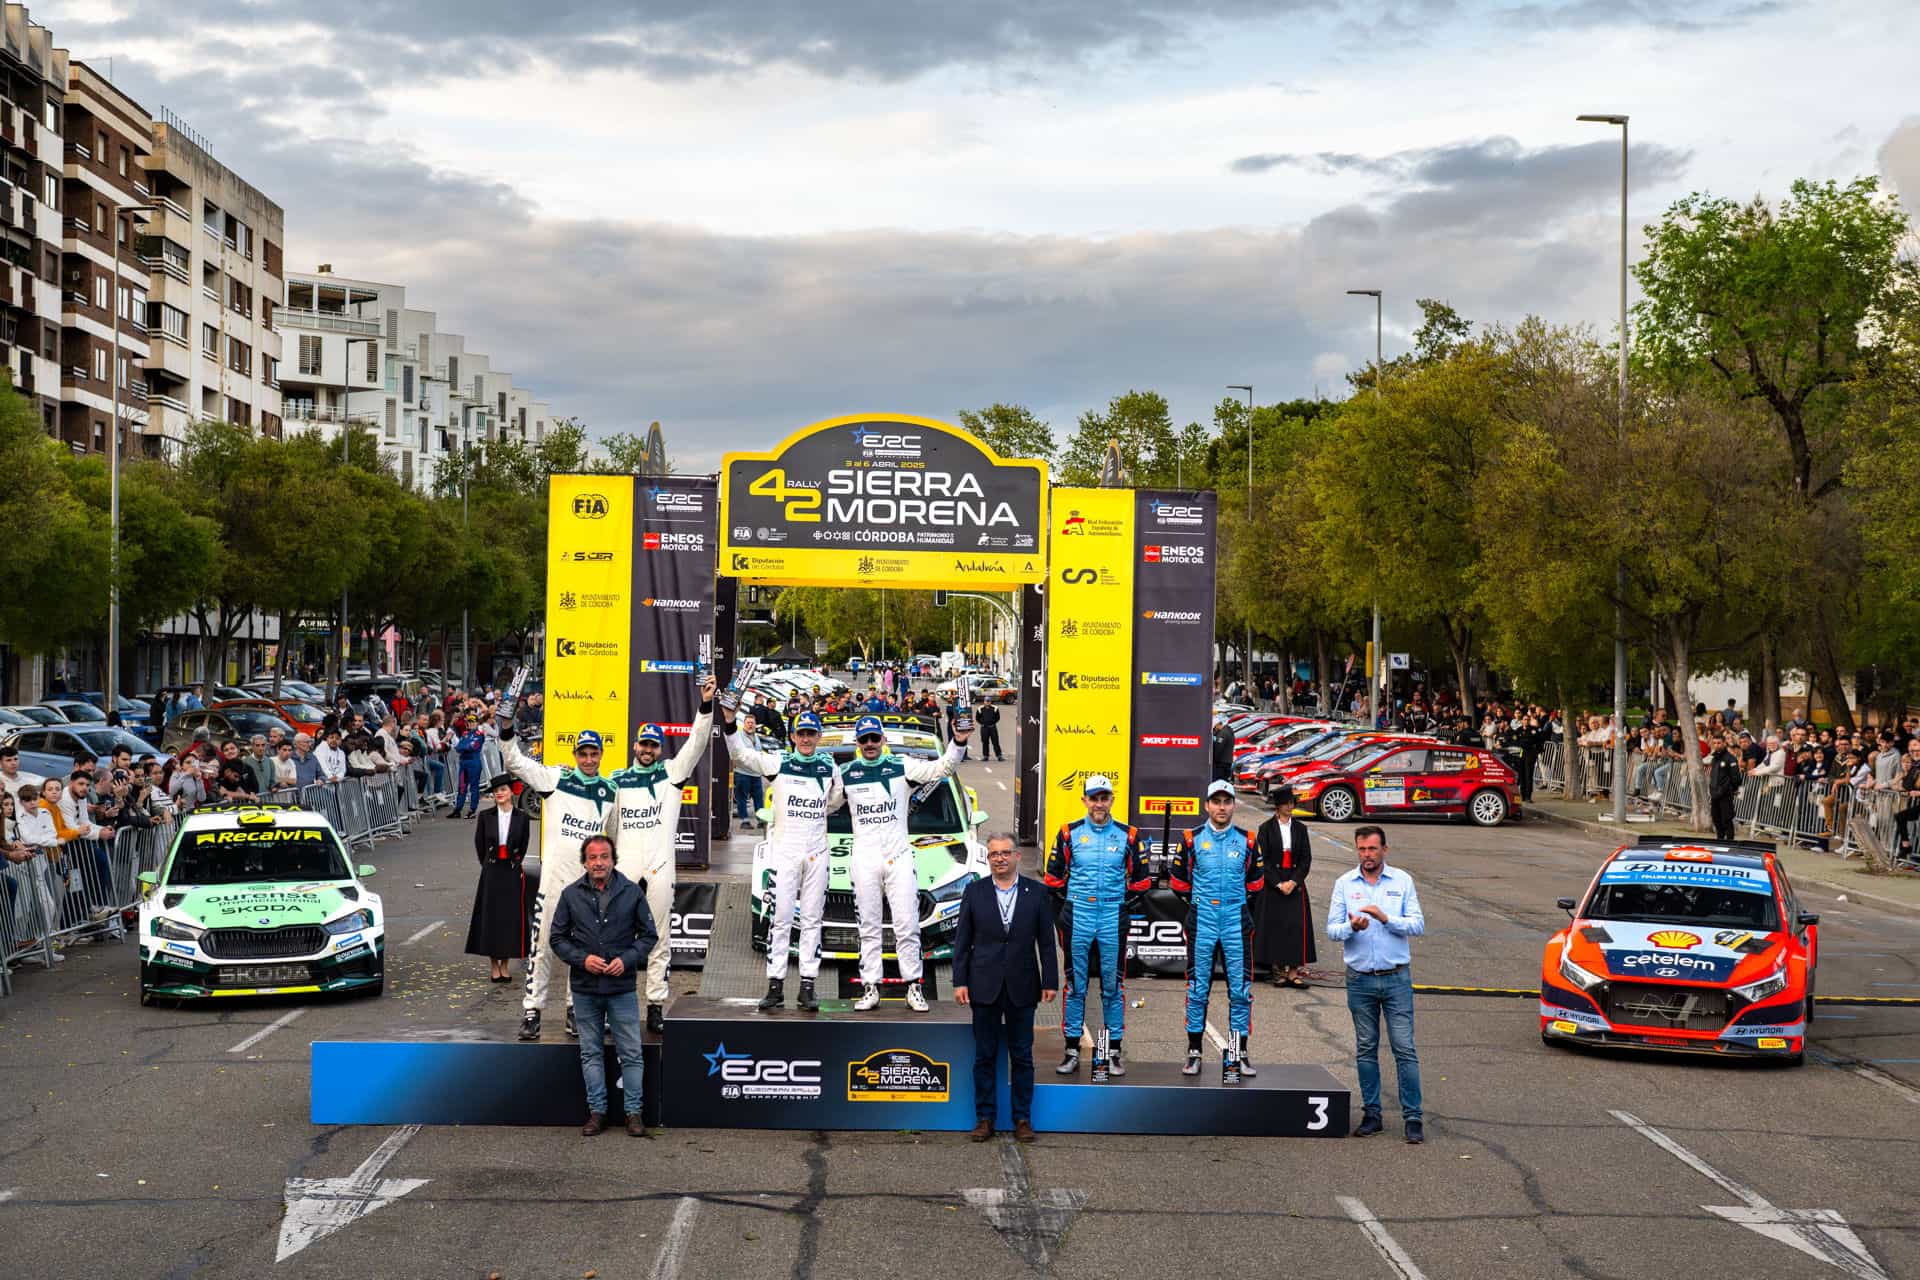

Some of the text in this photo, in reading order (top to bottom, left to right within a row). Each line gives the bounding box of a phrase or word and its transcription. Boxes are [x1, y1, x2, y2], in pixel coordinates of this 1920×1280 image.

[828, 470, 984, 497] SIERRA
[574, 499, 605, 514] FIA
[827, 498, 1020, 526] MORENA
[661, 533, 704, 543] ENEOS
[735, 529, 750, 539] FIA
[855, 529, 915, 543] CÓRDOBA
[692, 544, 704, 552] OIL
[1161, 546, 1204, 556] ENEOS
[579, 640, 618, 650] Diputación
[1081, 674, 1120, 683] Diputación
[1091, 682, 1120, 690] Córdoba
[1465, 755, 1479, 769] 23
[1078, 770, 1119, 779] PEGSUS
[621, 802, 662, 818] Recalvi
[856, 799, 897, 816] Recalvi
[217, 830, 302, 843] Recalvi
[1663, 864, 1751, 879] HYUNDAI
[206, 892, 318, 903] ourense
[218, 898, 278, 907] provincia
[1623, 952, 1716, 971] cetelem
[1569, 1012, 1600, 1025] HYUNDAI
[880, 1066, 930, 1075] SIERRA
[880, 1076, 941, 1085] MORENA
[722, 1086, 740, 1098] FIA
[1307, 1096, 1329, 1130] 3
